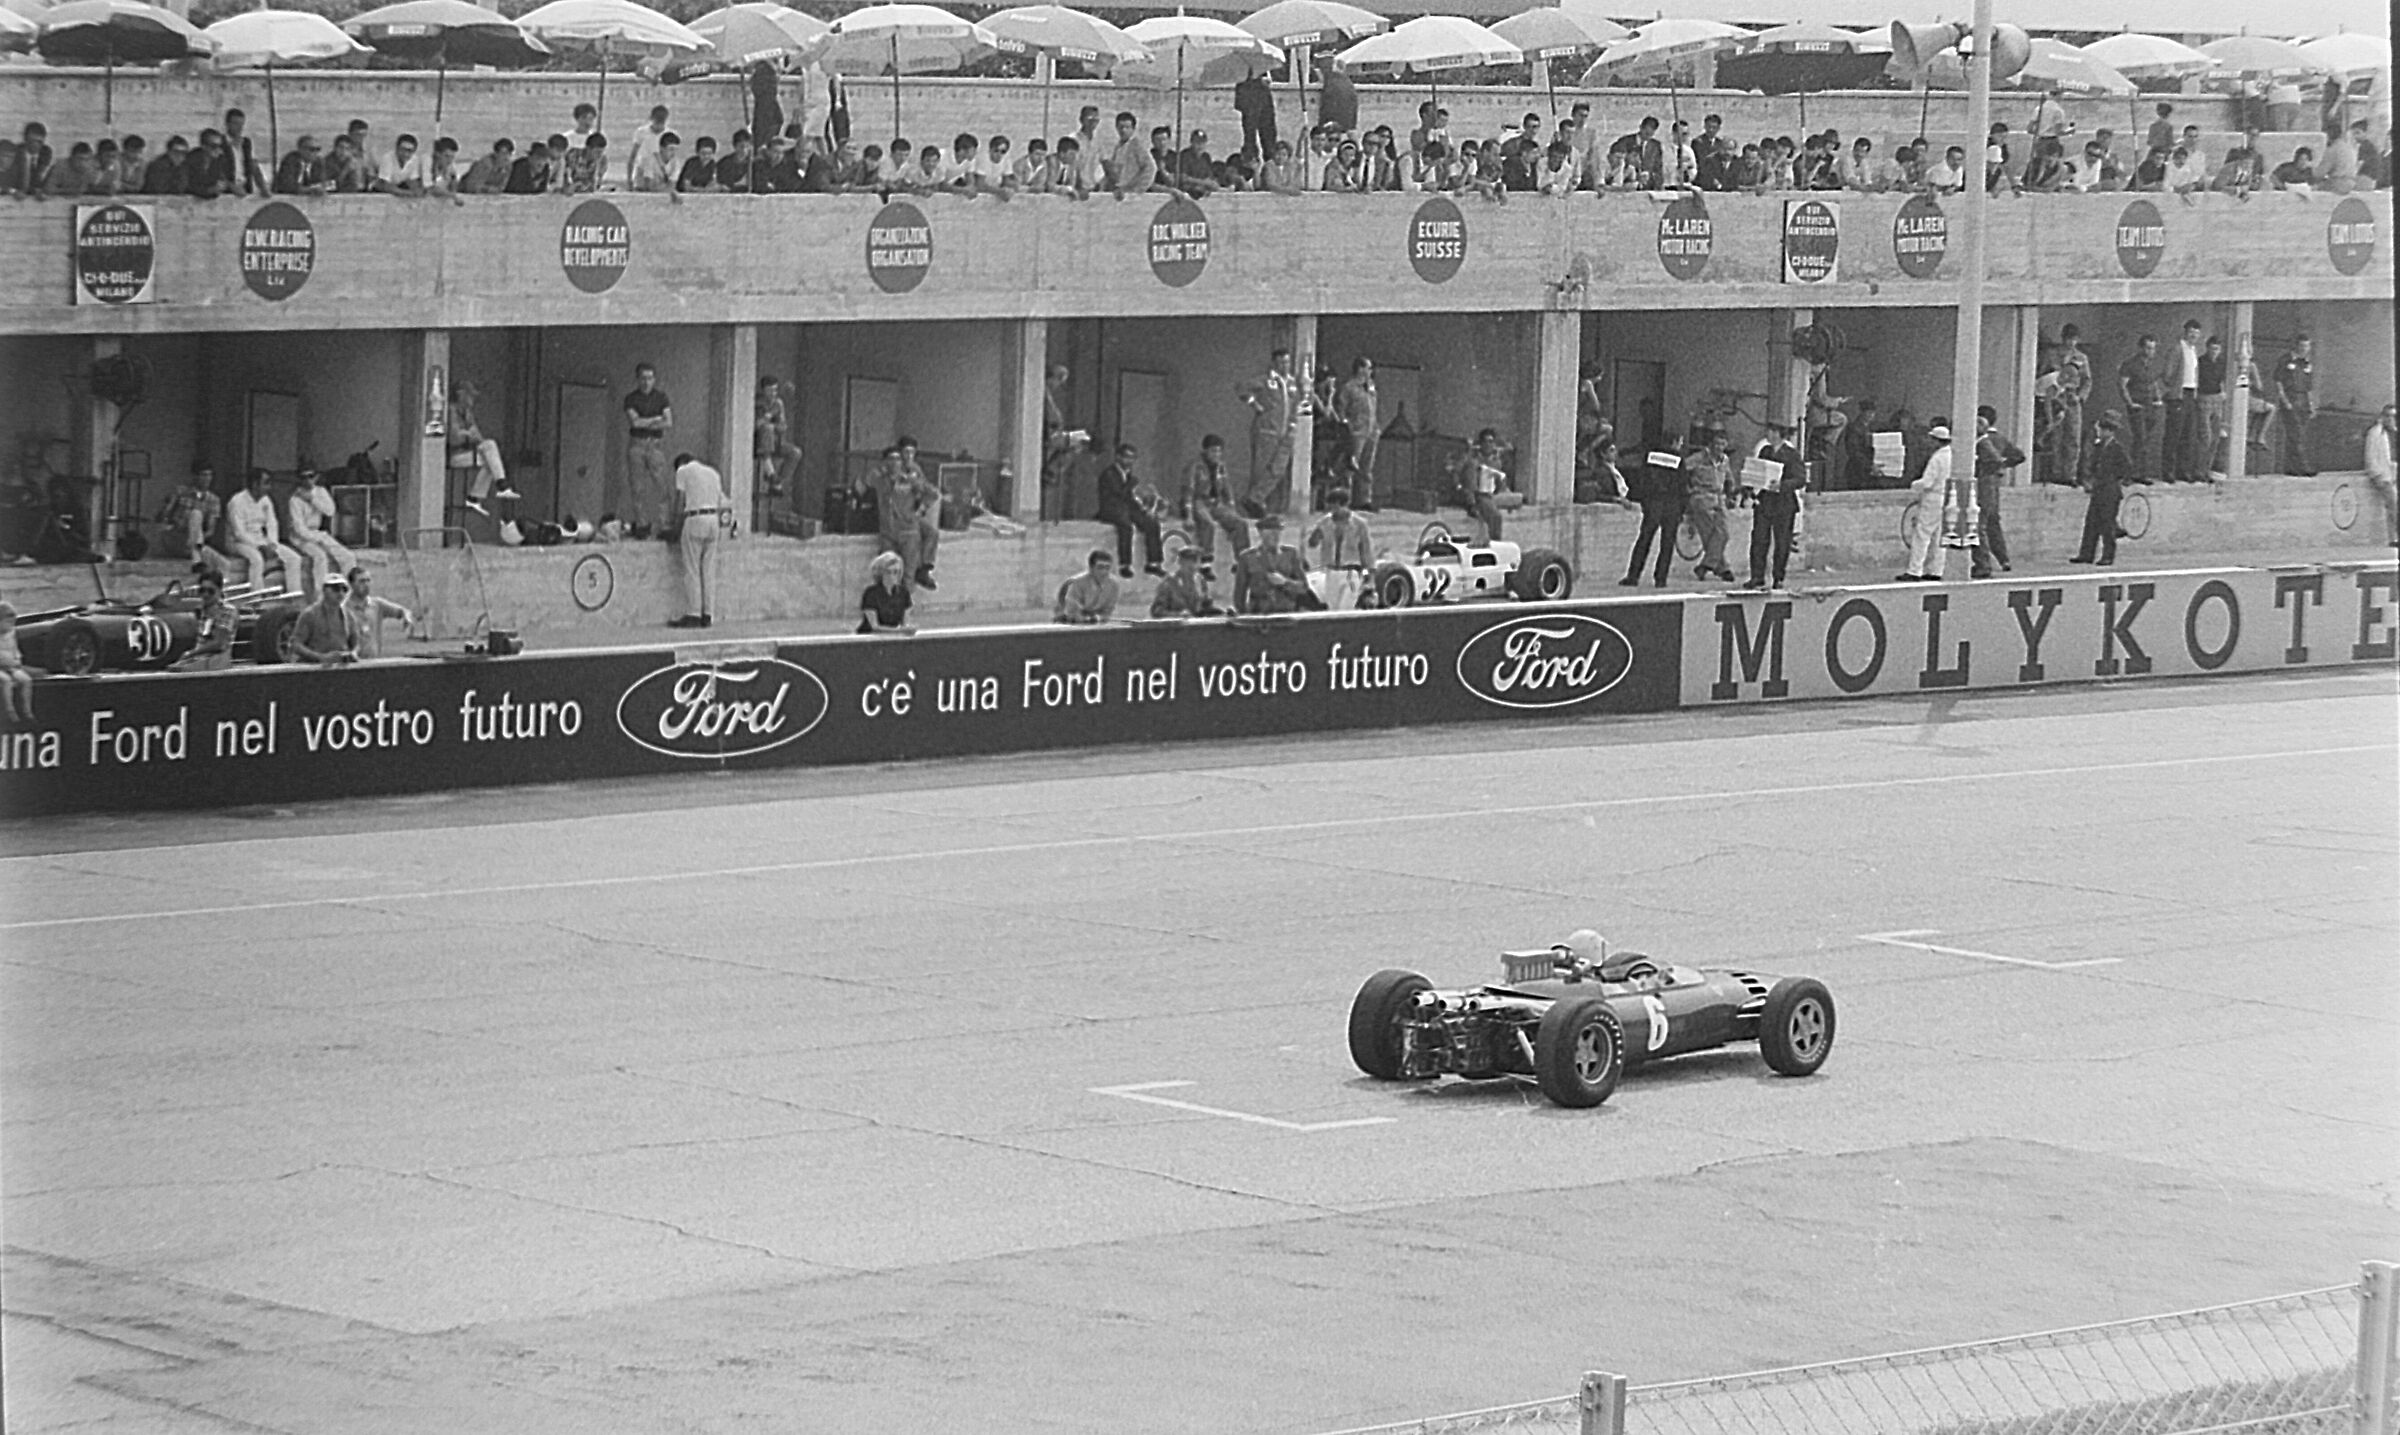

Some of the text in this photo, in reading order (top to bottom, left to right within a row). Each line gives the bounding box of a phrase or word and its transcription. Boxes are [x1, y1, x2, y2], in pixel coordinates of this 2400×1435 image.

[89, 223, 141, 234] SERVIZIO
[1418, 221, 1460, 238] ECURIE
[1796, 215, 1831, 225] SERVIZIO
[565, 226, 628, 244] RACING CAR
[1172, 222, 1206, 240] WALKER
[1788, 226, 1836, 236] ANTINCENDIO
[2119, 226, 2164, 247] TEAM LOTUS
[2330, 223, 2375, 244] TEAM LOTUS
[80, 235, 150, 247] ANTINCENDIO
[1416, 241, 1461, 258] SUISSE
[1660, 239, 1710, 255] MOTOR RACING
[1921, 236, 1945, 252] RACING
[244, 251, 311, 272] ENTERPRISE
[564, 247, 628, 266] DEVELOPMENTS
[1153, 243, 1208, 262] RACING TEAM
[588, 571, 598, 590] 5
[1421, 567, 1451, 602] 32
[127, 617, 170, 660] 30
[1711, 571, 2397, 701] MOLYKOTE
[1492, 626, 1601, 692] Ford
[937, 677, 999, 713] una
[1023, 656, 1104, 709] Ford
[1126, 651, 1177, 703] nel
[1198, 650, 1307, 698] vostro
[1327, 643, 1430, 691] futuro
[659, 669, 790, 740] Ford
[91, 707, 188, 765] Ford
[216, 702, 277, 757] nel
[303, 699, 434, 751] vostro
[459, 690, 583, 742] futuro
[1643, 995, 1669, 1051] 6
